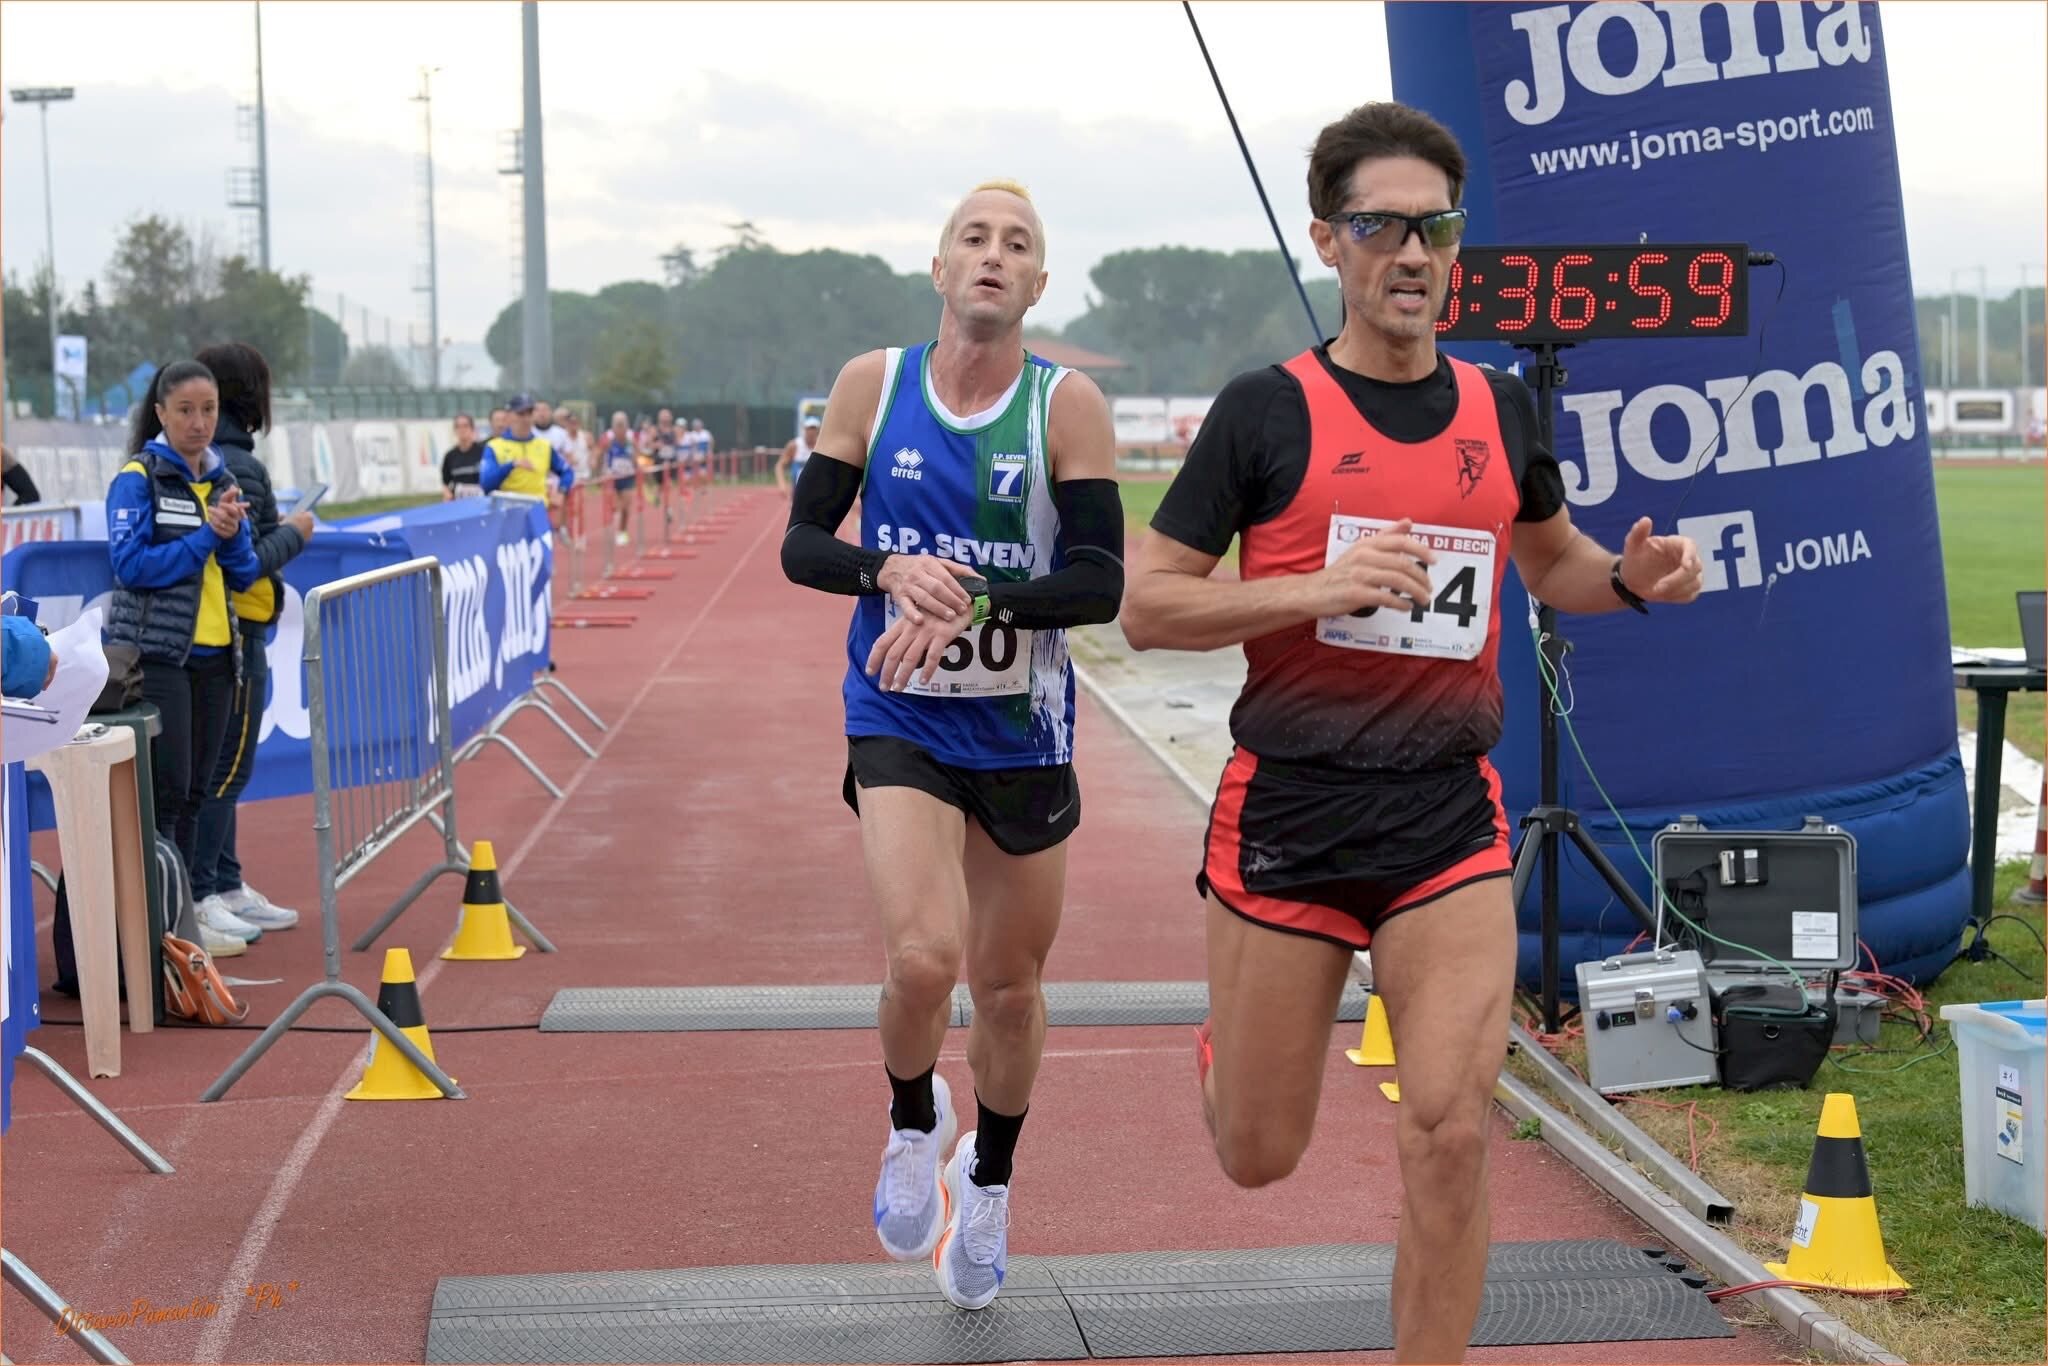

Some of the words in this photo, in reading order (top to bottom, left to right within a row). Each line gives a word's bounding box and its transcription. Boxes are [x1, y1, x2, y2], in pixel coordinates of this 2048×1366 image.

[1530, 105, 1874, 175] www.joma-sport.com
[1559, 350, 1915, 506] Joma
[891, 466, 922, 481] errea
[993, 461, 1024, 496] 7
[877, 523, 929, 555] S.P.
[935, 533, 1035, 569] SEVEN
[1433, 535, 1450, 549] DI
[1453, 538, 1489, 553] BECH
[1775, 530, 1872, 575] JOMA
